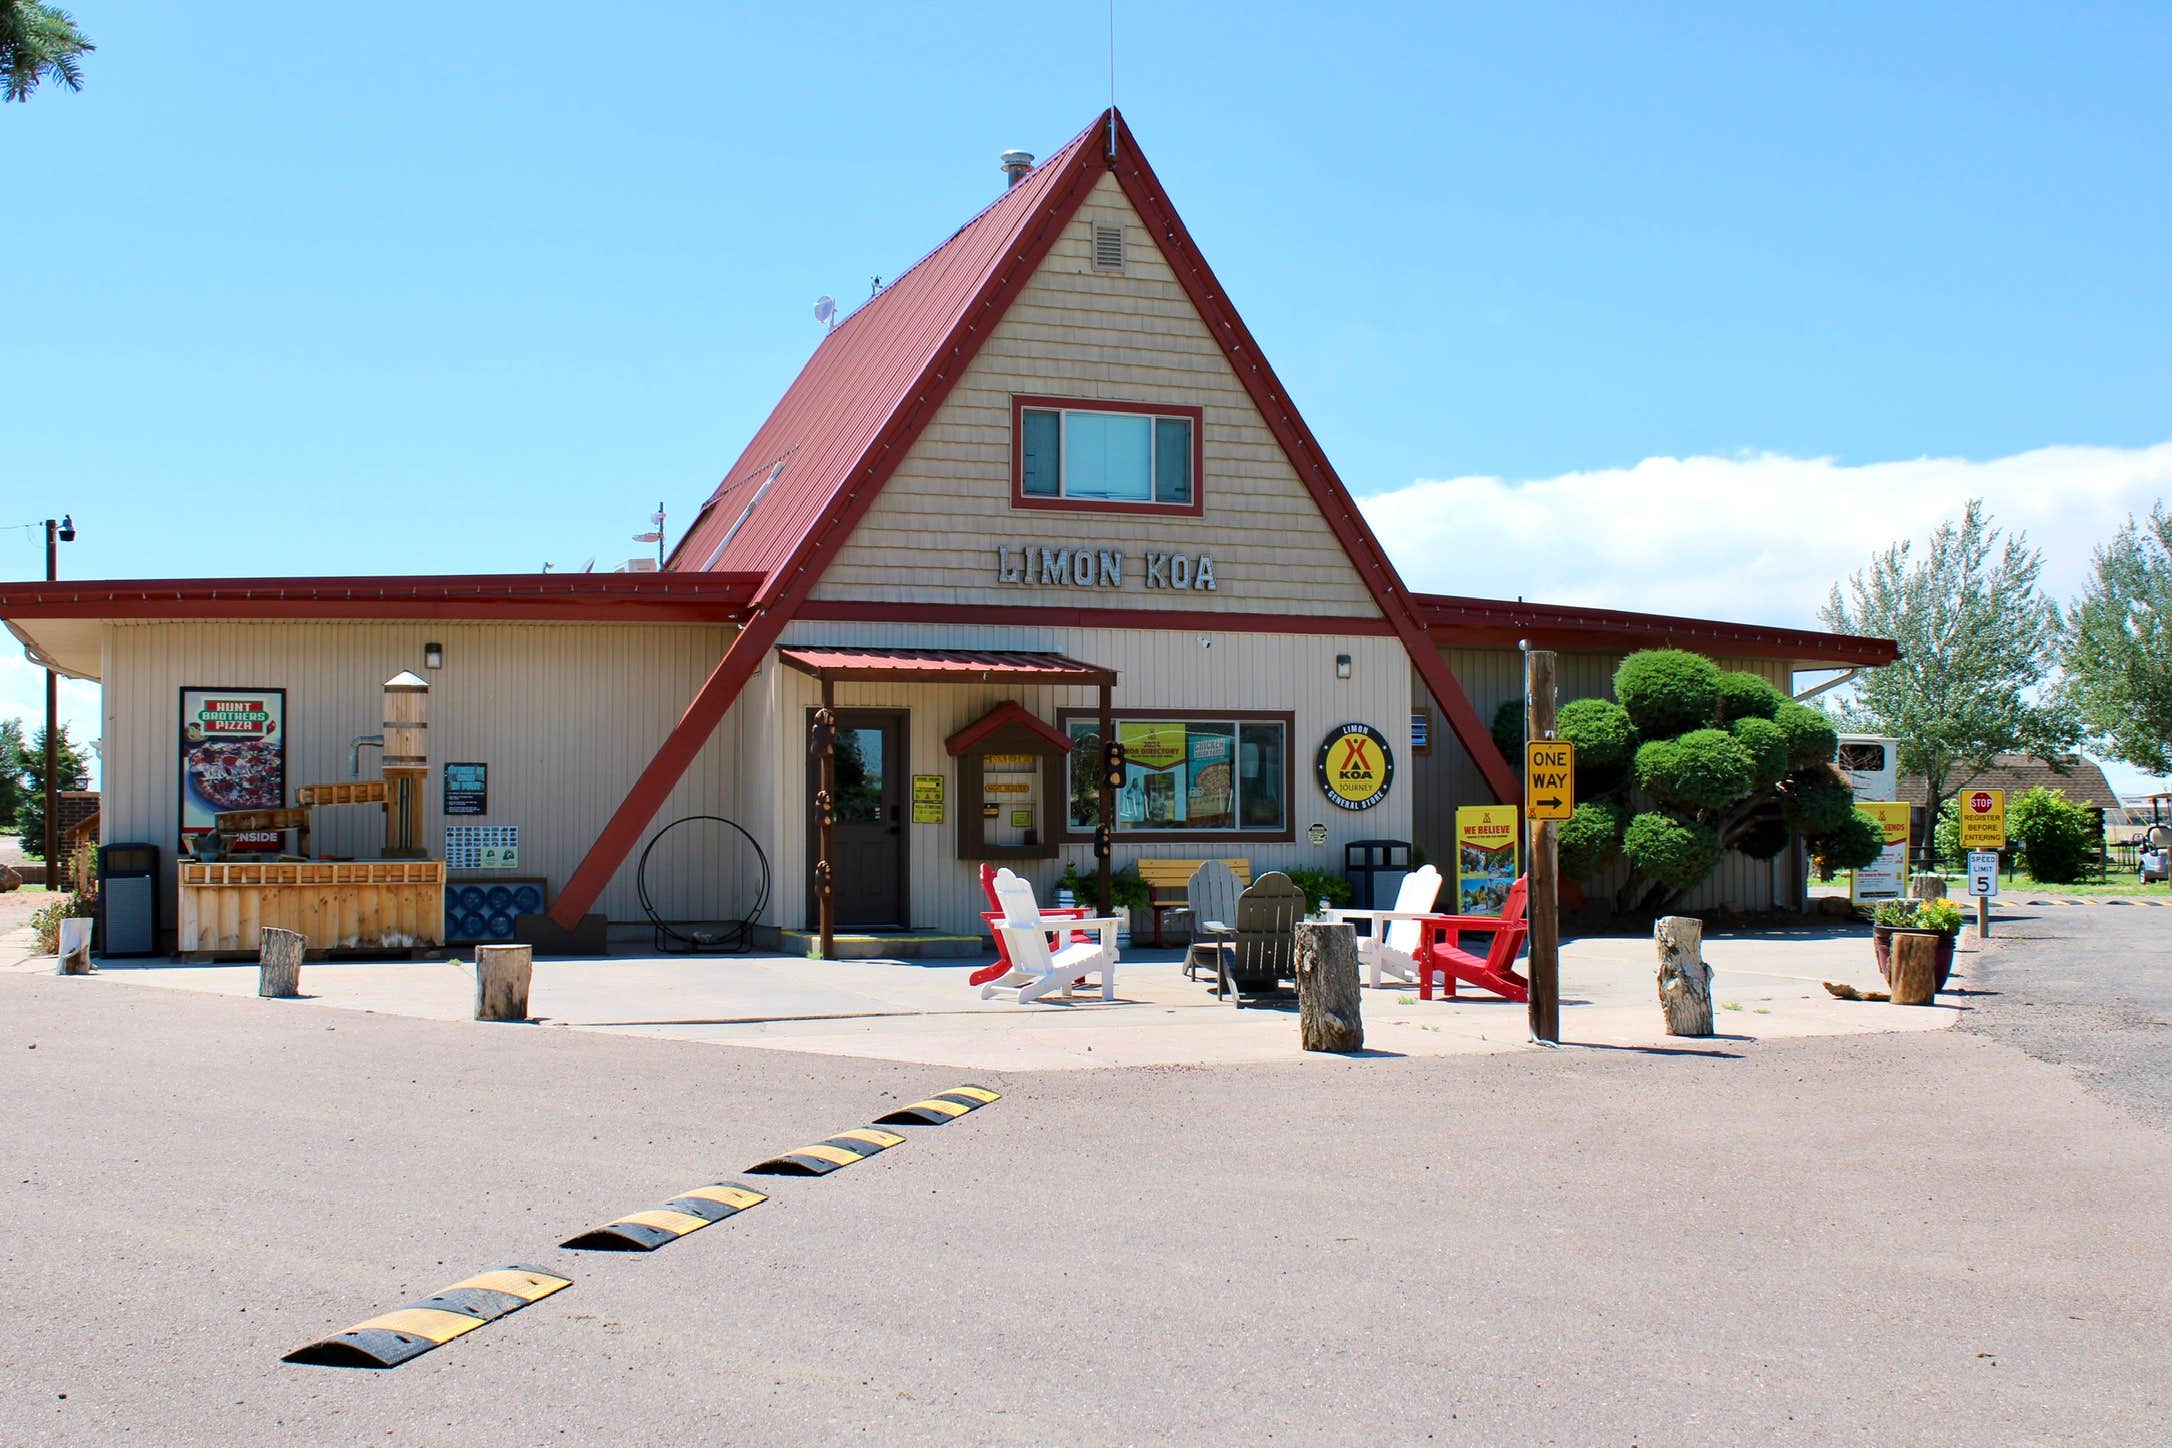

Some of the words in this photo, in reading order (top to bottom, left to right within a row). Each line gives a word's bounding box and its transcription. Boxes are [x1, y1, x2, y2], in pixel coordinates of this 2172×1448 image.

[998, 546, 1123, 587] LIMON
[1146, 552, 1217, 591] KOA
[216, 702, 252, 712] HUNT
[202, 711, 266, 721] BROTHERS
[215, 720, 253, 730] PIZZA
[1343, 725, 1369, 735] LIMON
[1533, 751, 1567, 767] ONE
[1340, 770, 1374, 779] KOA
[1533, 773, 1567, 789] WAY
[1340, 783, 1373, 793] JOURNEY
[1327, 790, 1359, 810] GENERAL
[1361, 790, 1384, 809] STORE
[1971, 798, 1993, 808] STOP
[1464, 825, 1477, 835] WE
[1478, 824, 1511, 835] BELIEVE
[1967, 823, 1998, 832] BEFORE
[1971, 855, 1995, 863] SPEED
[1977, 876, 1990, 893] 5
